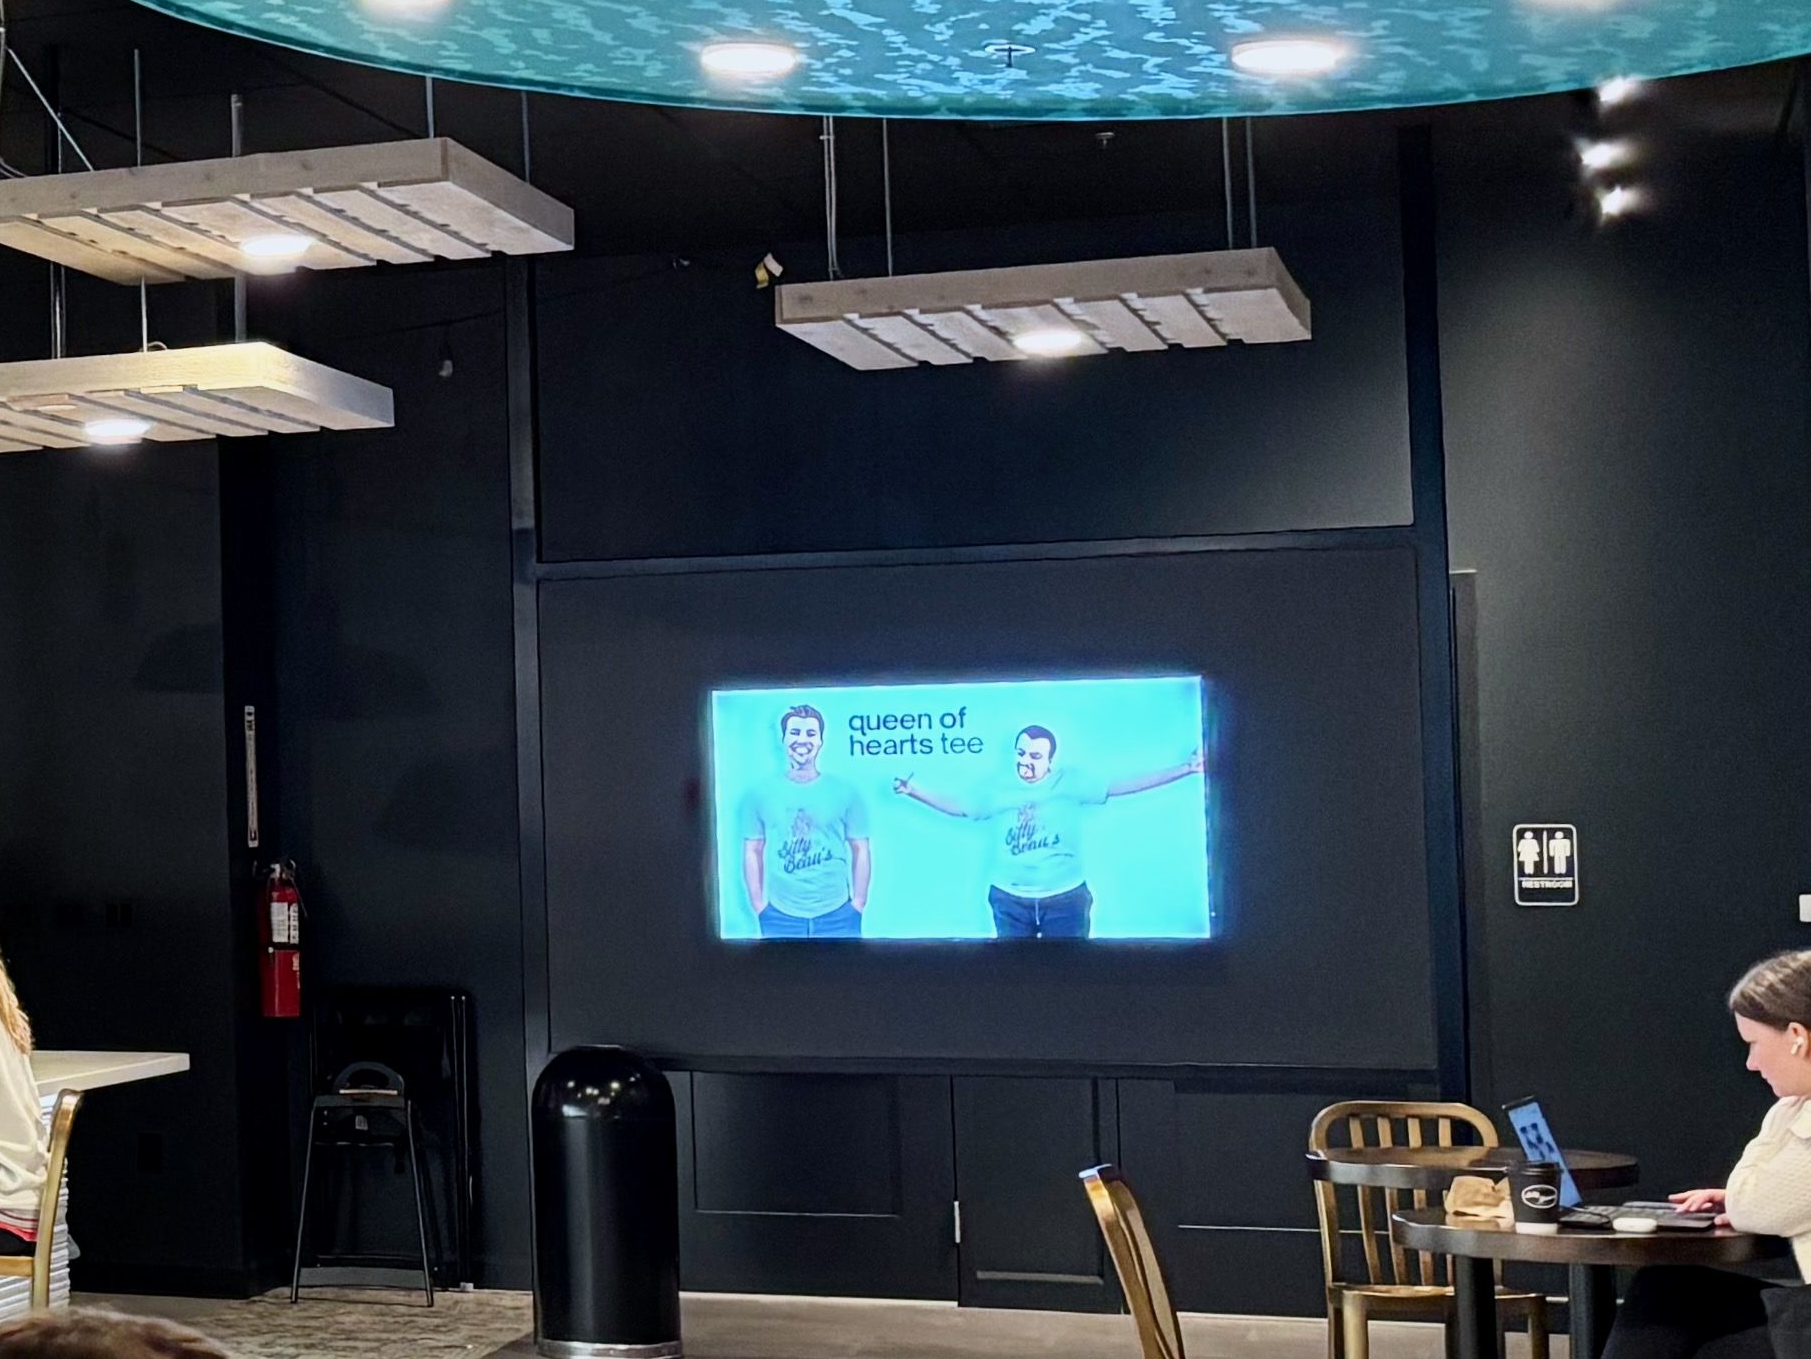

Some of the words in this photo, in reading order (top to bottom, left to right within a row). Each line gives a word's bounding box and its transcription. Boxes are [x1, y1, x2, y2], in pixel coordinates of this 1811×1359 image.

[849, 713, 932, 738] queen
[940, 707, 966, 730] of
[850, 733, 933, 757] hearts
[941, 734, 984, 755] tee
